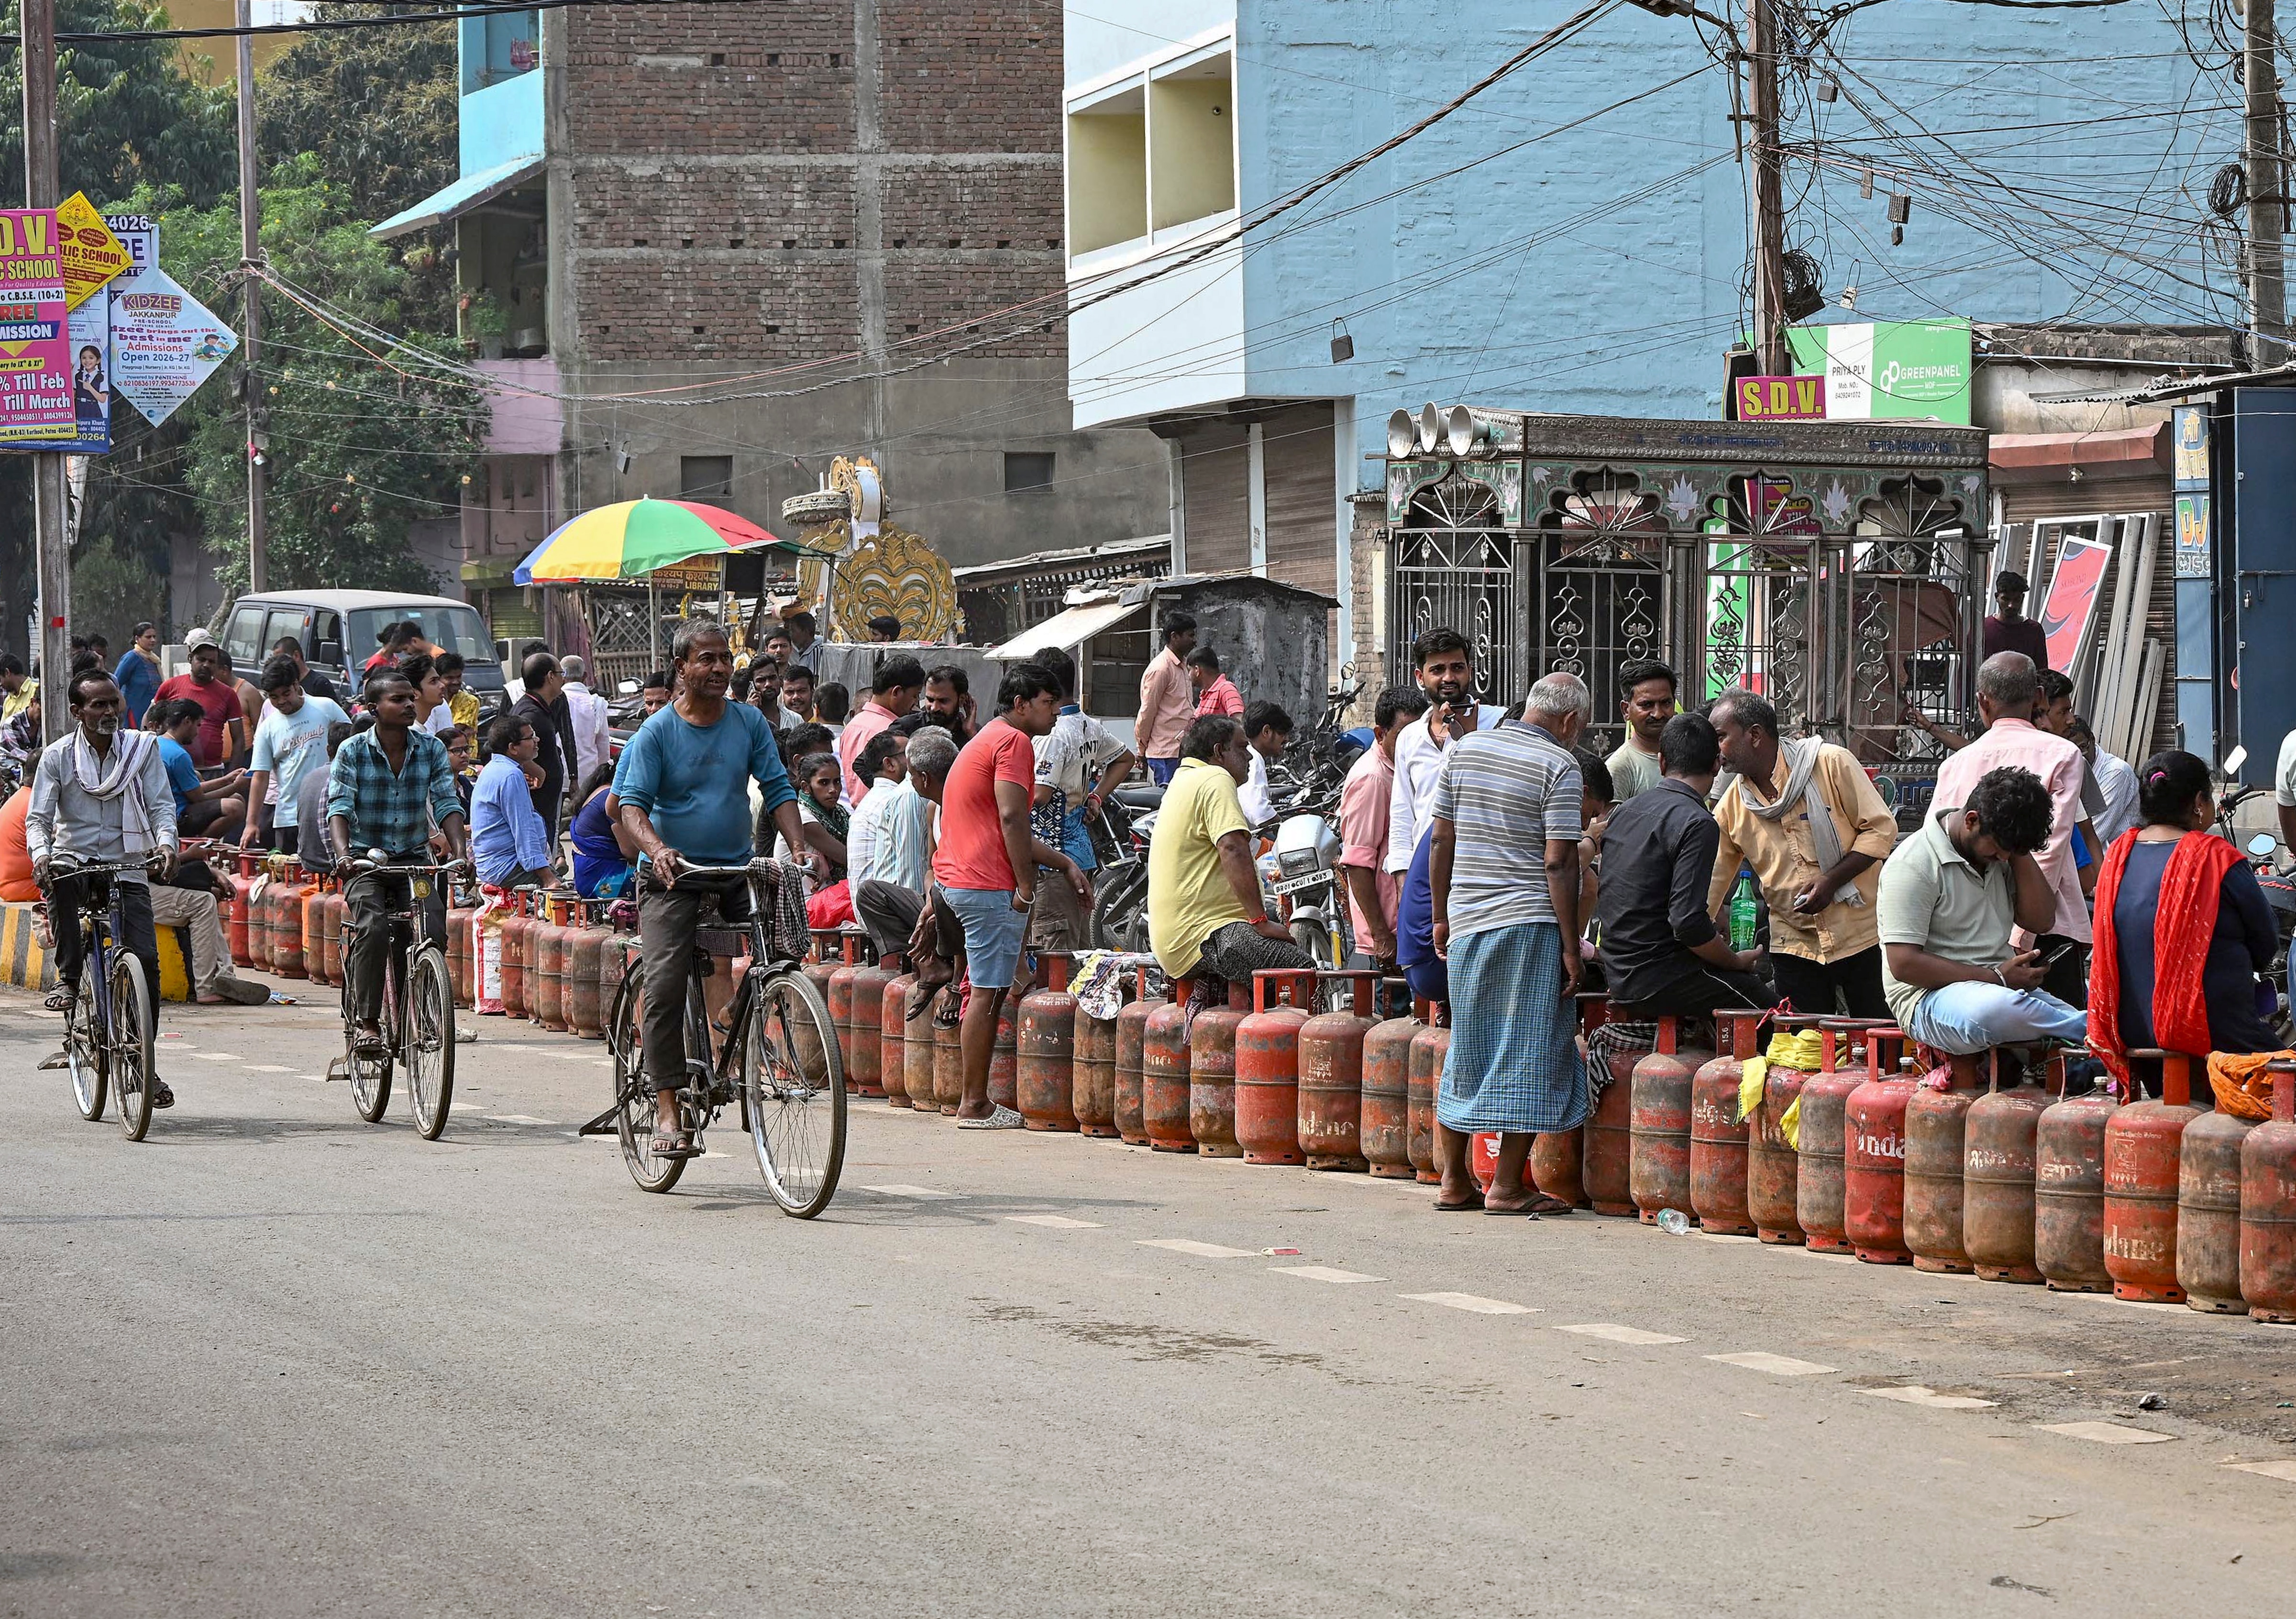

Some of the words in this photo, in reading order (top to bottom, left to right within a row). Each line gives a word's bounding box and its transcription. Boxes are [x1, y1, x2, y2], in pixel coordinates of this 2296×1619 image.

[79, 231, 106, 242] Admission
[81, 248, 121, 265] SCHOOL
[7, 259, 60, 280] SCHOOL
[83, 260, 111, 269] Curriculum
[8, 291, 36, 301] C.B.S.E.
[38, 290, 63, 301] (10+2)
[122, 294, 181, 310] KIDZEE
[119, 333, 154, 341] best
[127, 341, 184, 352] Admissions
[121, 352, 150, 363] Open
[1832, 366, 1851, 376] PRIYA
[1853, 364, 1866, 375] PLY
[1900, 364, 1961, 380] GREENPANEL
[13, 373, 36, 390] Till
[40, 372, 65, 390] Feb
[3, 394, 25, 411] Till
[29, 392, 71, 410] March
[1743, 379, 1822, 416] S.D.V.
[2177, 497, 2209, 546] DJ
[685, 571, 710, 582] कश्यप
[685, 581, 718, 591] LIBRARY
[282, 724, 325, 757] Originals
